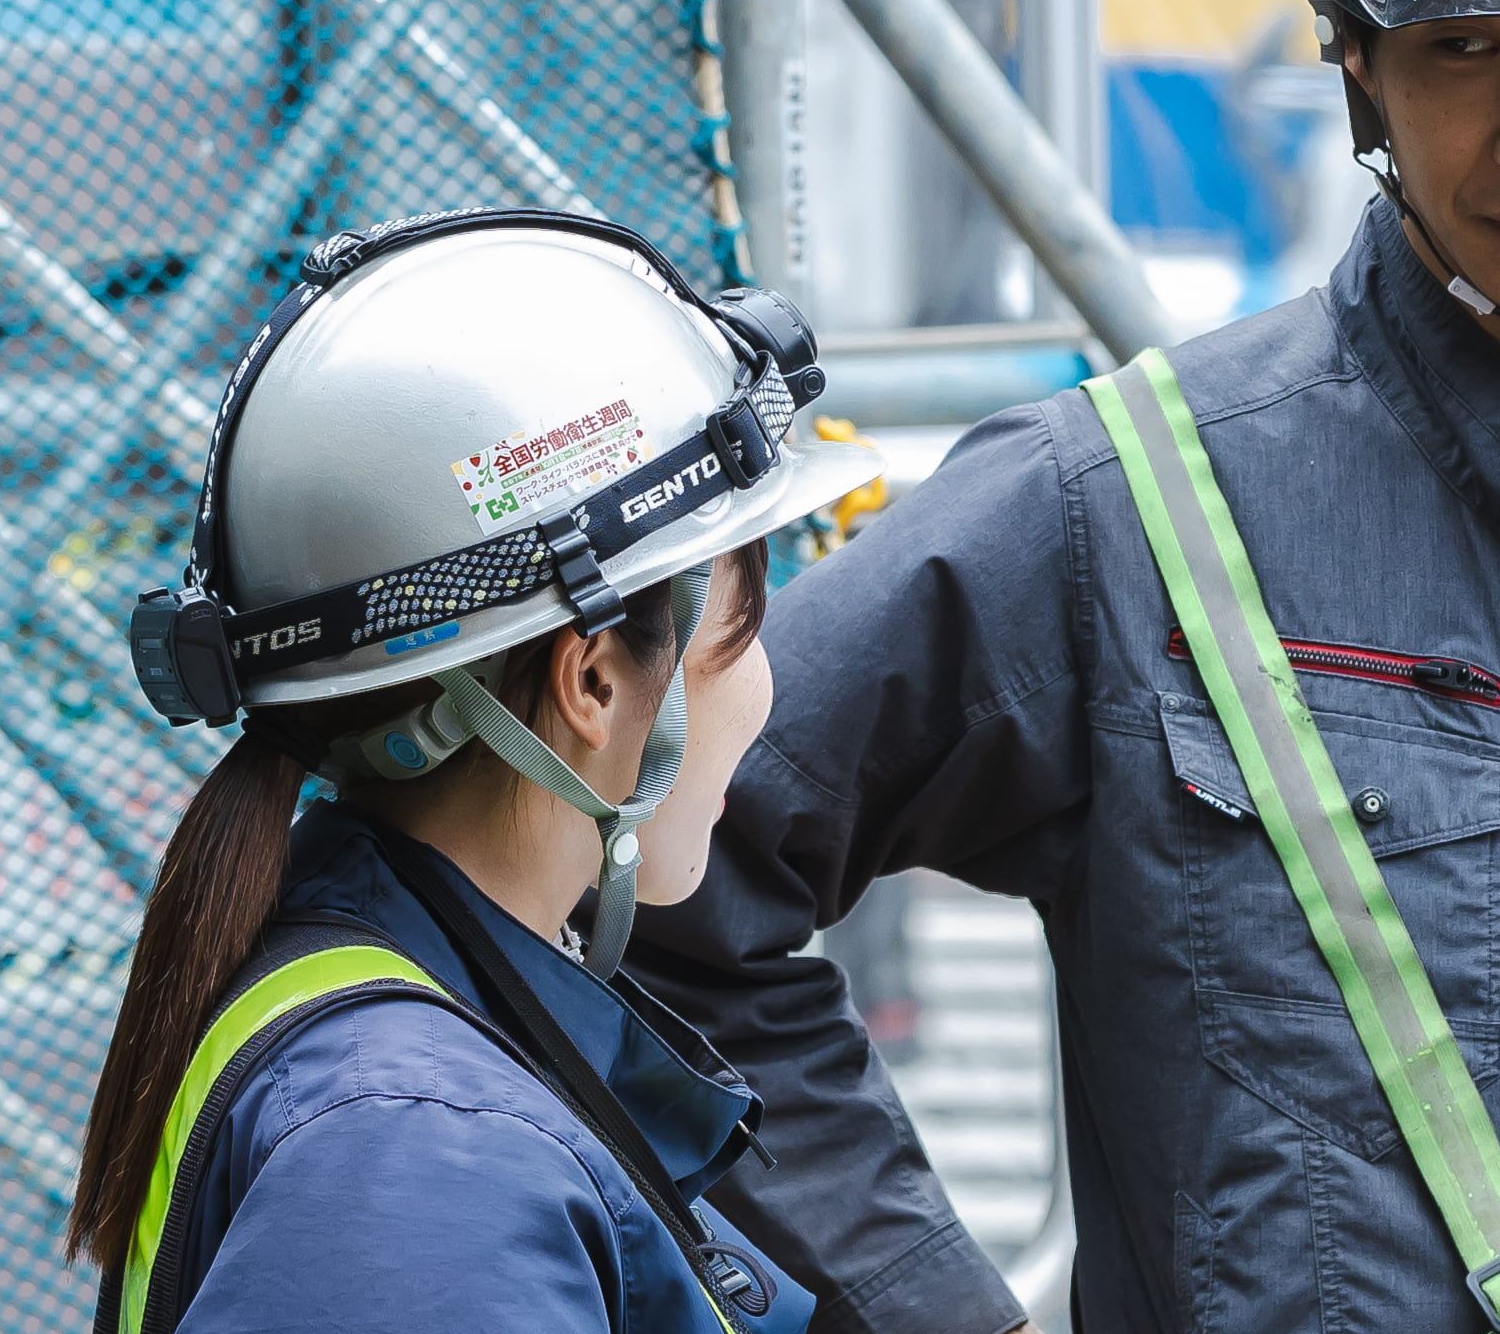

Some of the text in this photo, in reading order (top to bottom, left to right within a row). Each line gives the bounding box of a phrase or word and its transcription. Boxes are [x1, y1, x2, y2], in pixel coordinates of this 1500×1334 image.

[493, 399, 632, 477] 全国労働衛生週間
